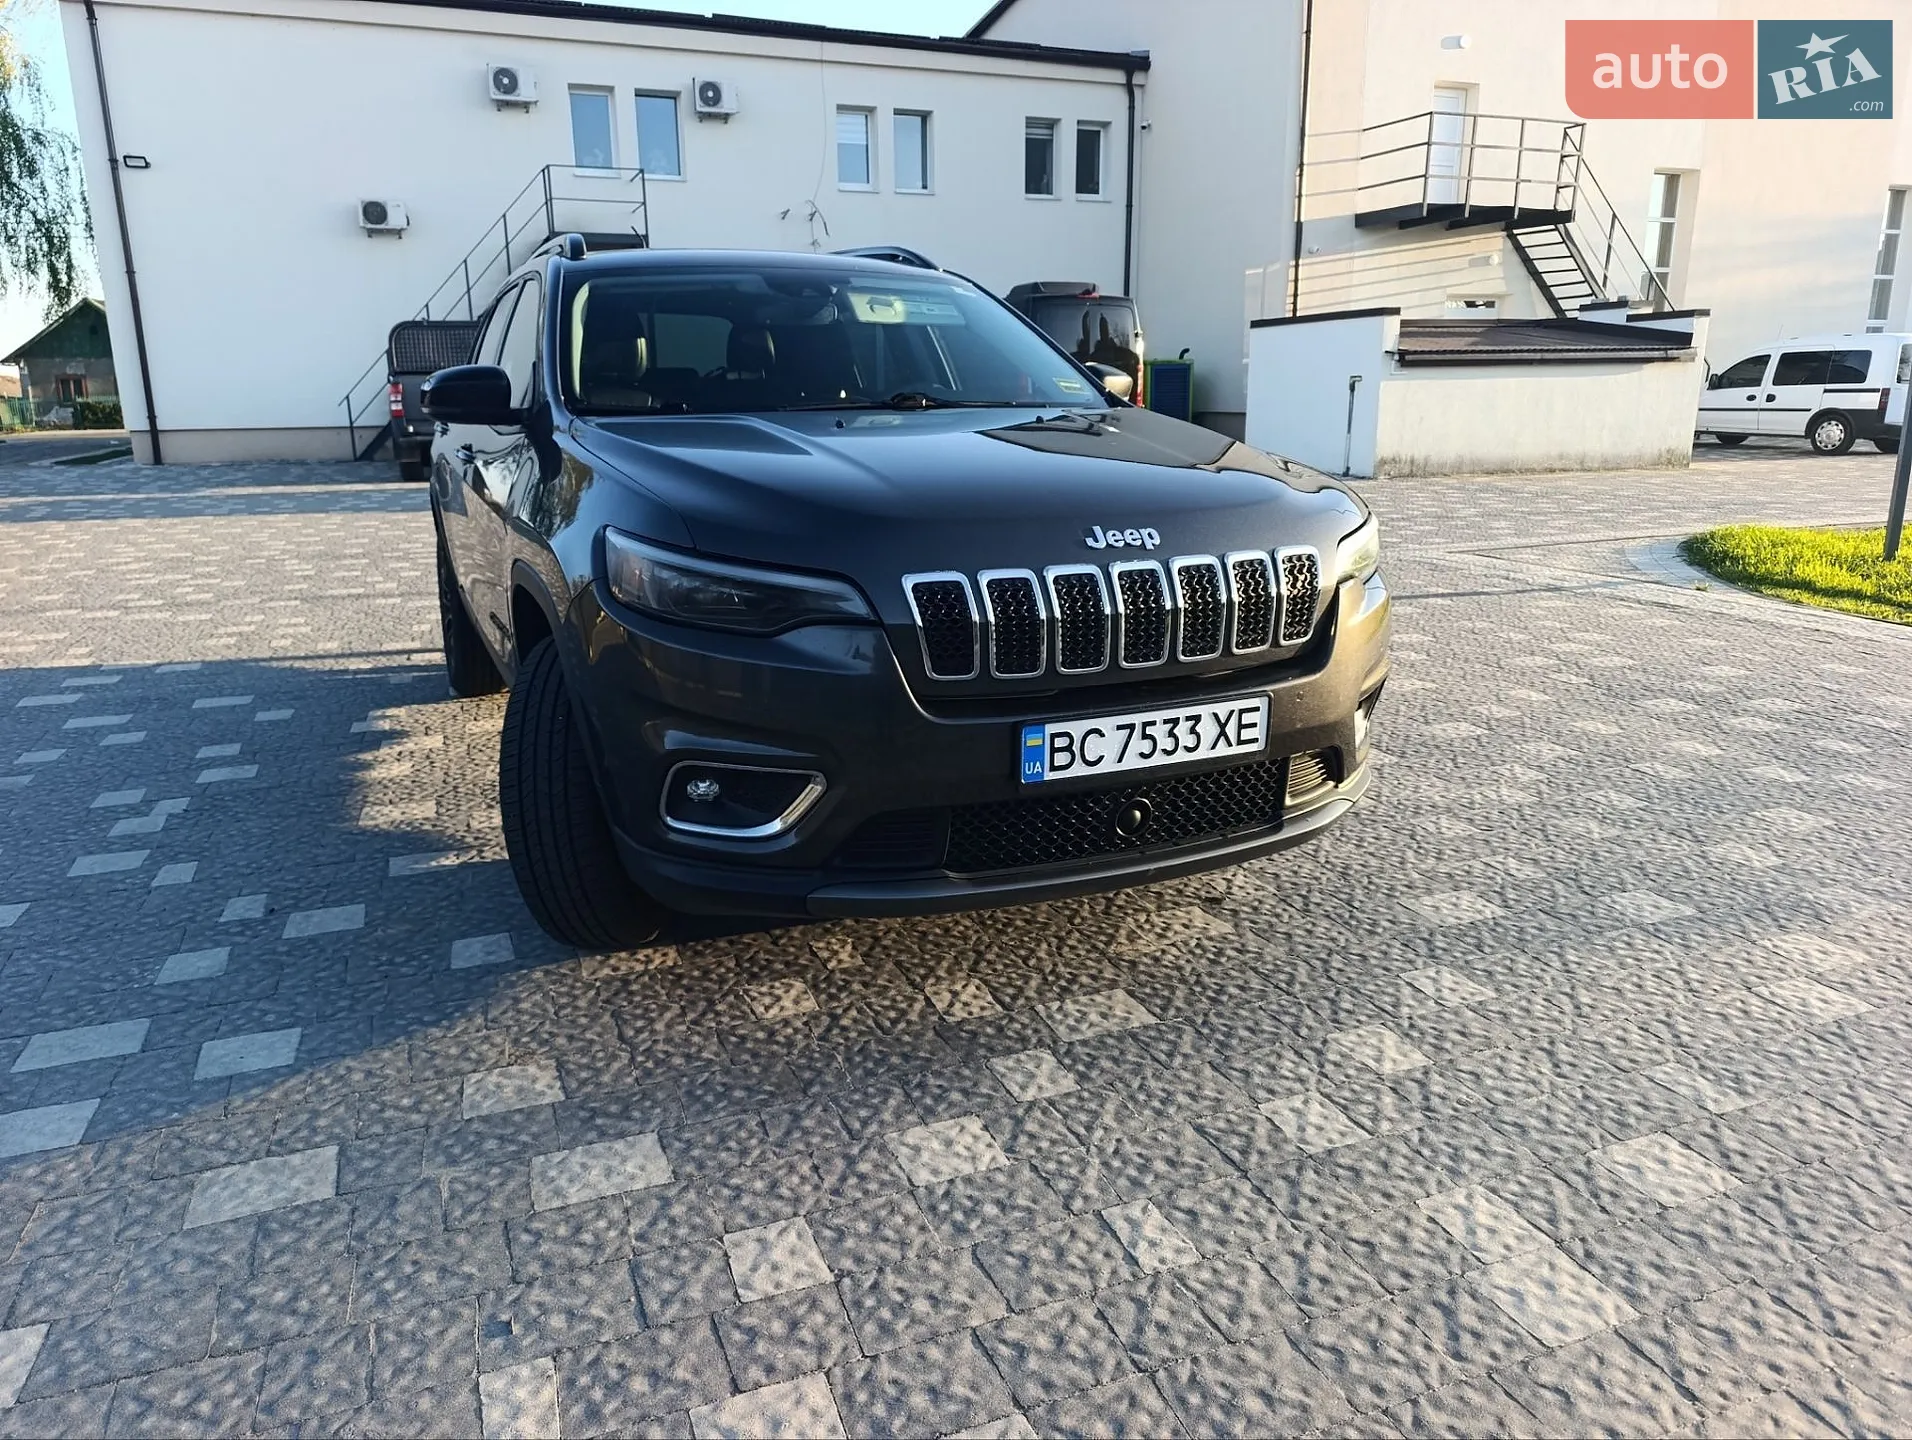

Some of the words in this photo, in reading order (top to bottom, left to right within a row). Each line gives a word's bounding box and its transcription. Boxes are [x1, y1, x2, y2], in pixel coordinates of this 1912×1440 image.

[1084, 525, 1161, 550] Jeep
[1049, 727, 1106, 772] BC
[1115, 714, 1203, 763] 7533
[1210, 706, 1261, 750] XE
[1025, 763, 1042, 774] UA
